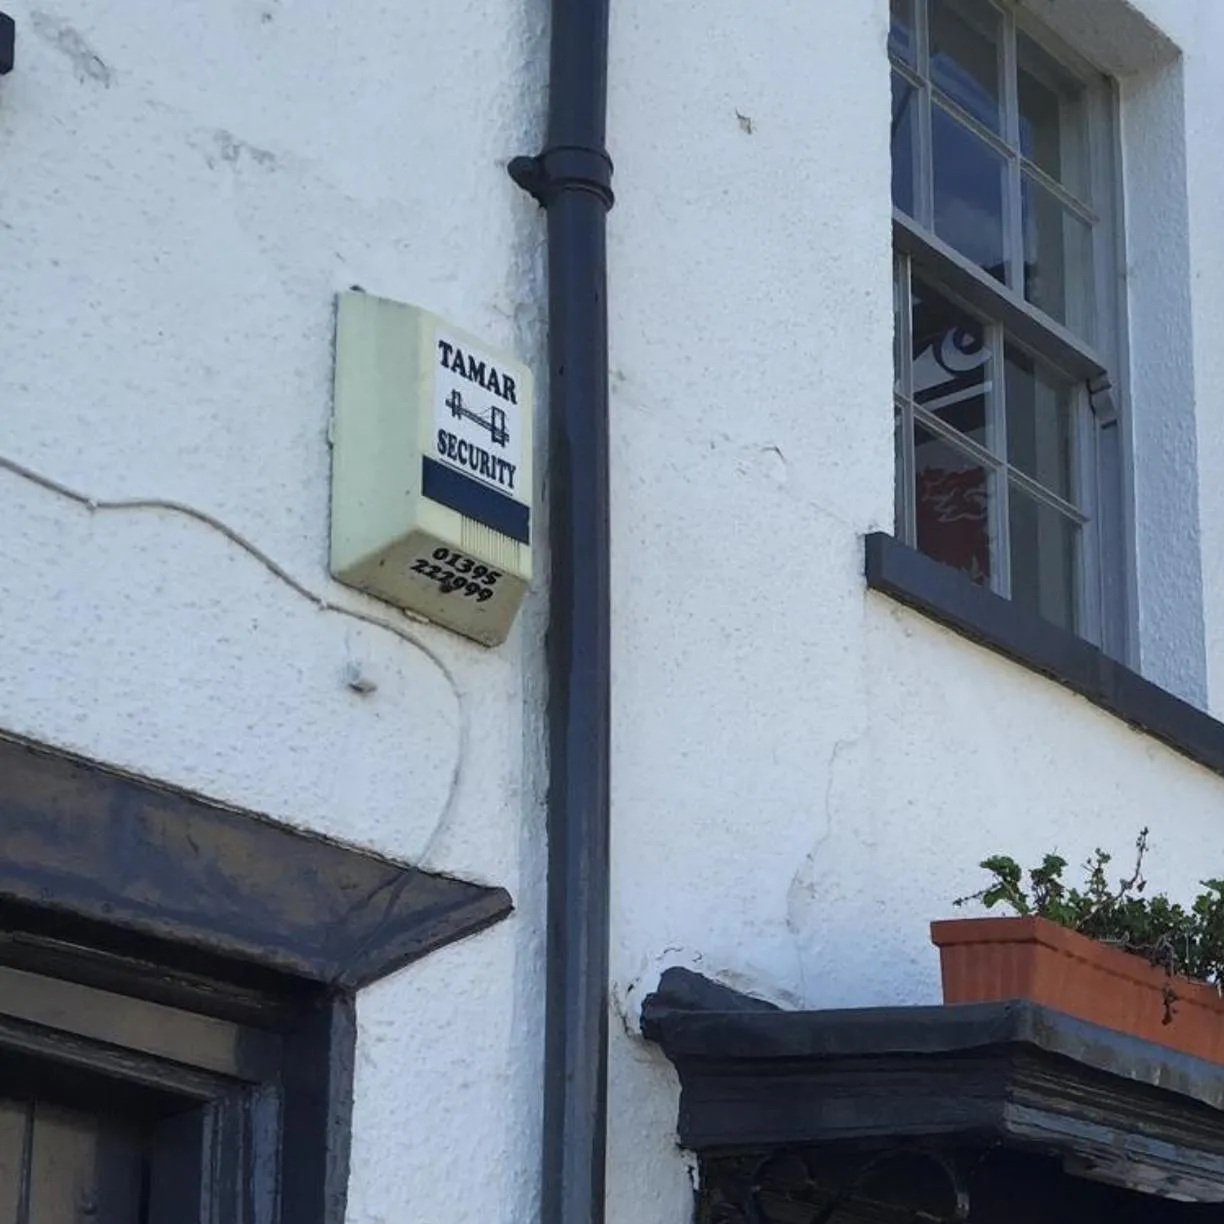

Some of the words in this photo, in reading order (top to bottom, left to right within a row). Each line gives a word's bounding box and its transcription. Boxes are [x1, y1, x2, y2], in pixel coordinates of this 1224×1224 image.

[437, 339, 518, 405] TAMAR
[436, 428, 517, 491] SECURITY
[410, 558, 495, 603] 222999
[431, 546, 502, 587] 01395
